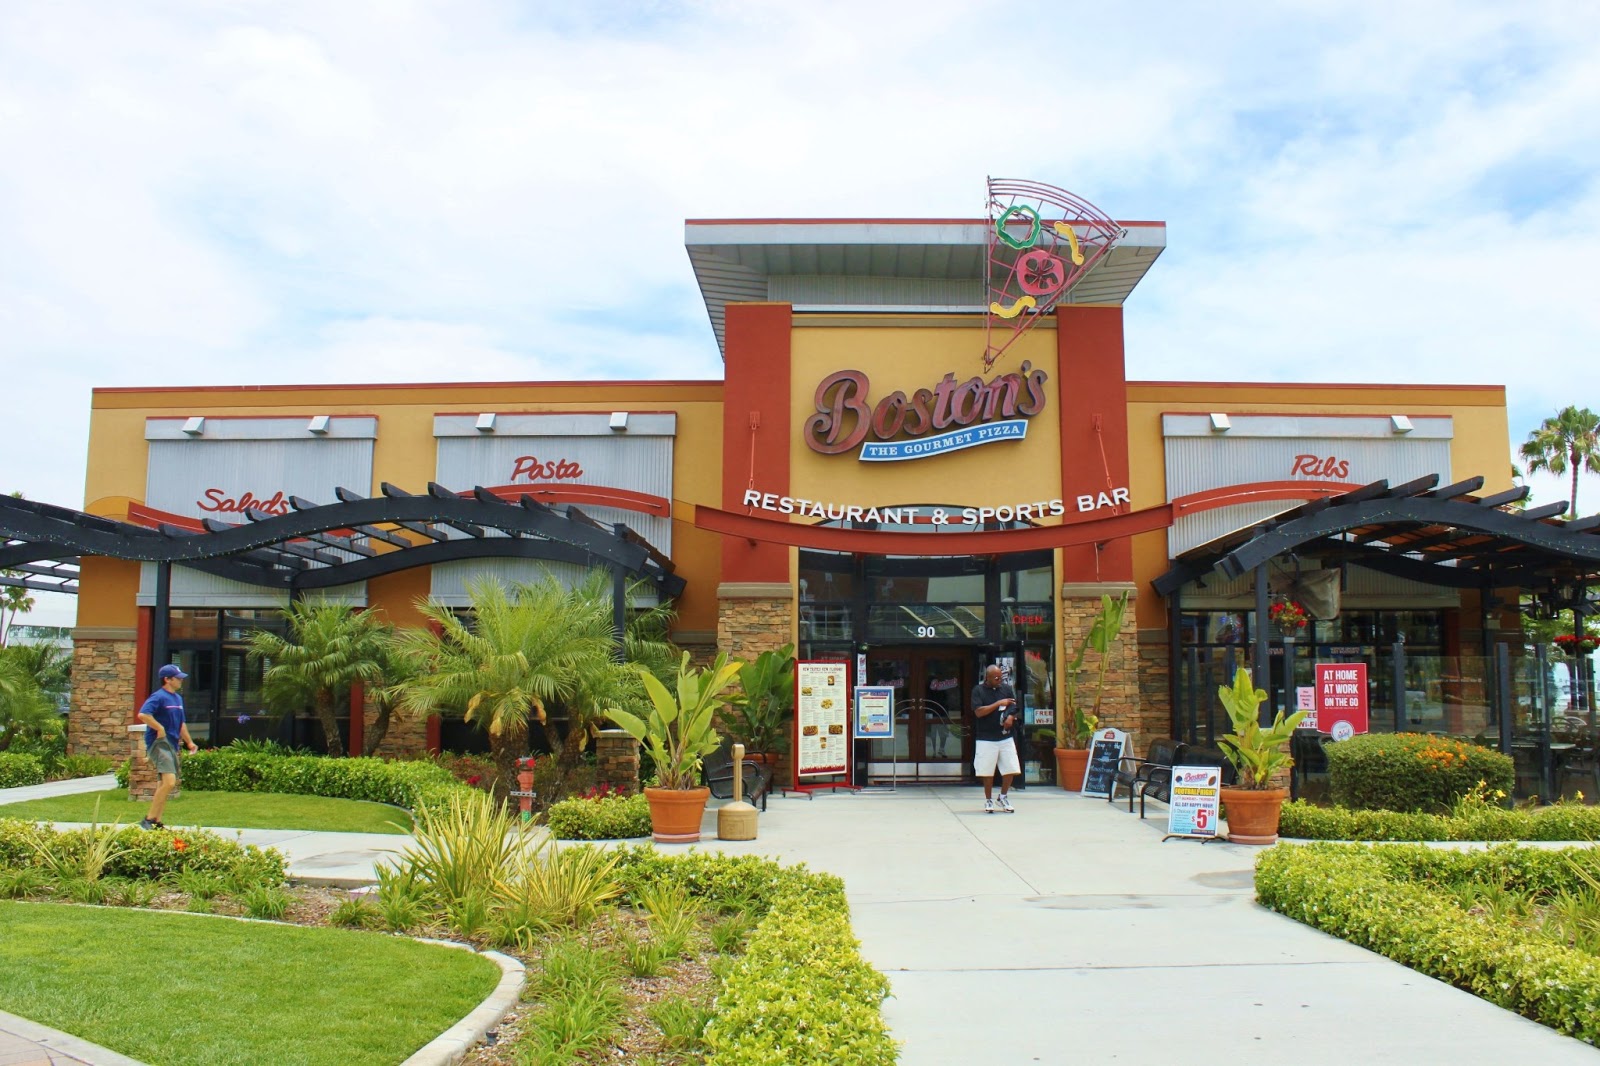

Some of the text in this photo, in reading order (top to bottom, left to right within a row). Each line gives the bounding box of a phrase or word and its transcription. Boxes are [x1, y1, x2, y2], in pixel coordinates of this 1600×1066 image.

[804, 360, 1048, 454] Boston's
[869, 425, 1021, 456] THE GOURMET PIZZA
[510, 455, 583, 481] Pasta
[1290, 454, 1350, 479] Ribs
[196, 488, 289, 516] Salads
[743, 487, 1131, 525] RESTAURANT & SPORTS BAR
[1011, 615, 1043, 625] OPEN
[917, 626, 936, 638] 90
[1323, 670, 1358, 680] AT HOME
[1323, 684, 1359, 694] AT WORK
[1324, 698, 1359, 707] ON THE GO
[1174, 787, 1200, 796] FOOTBALL
